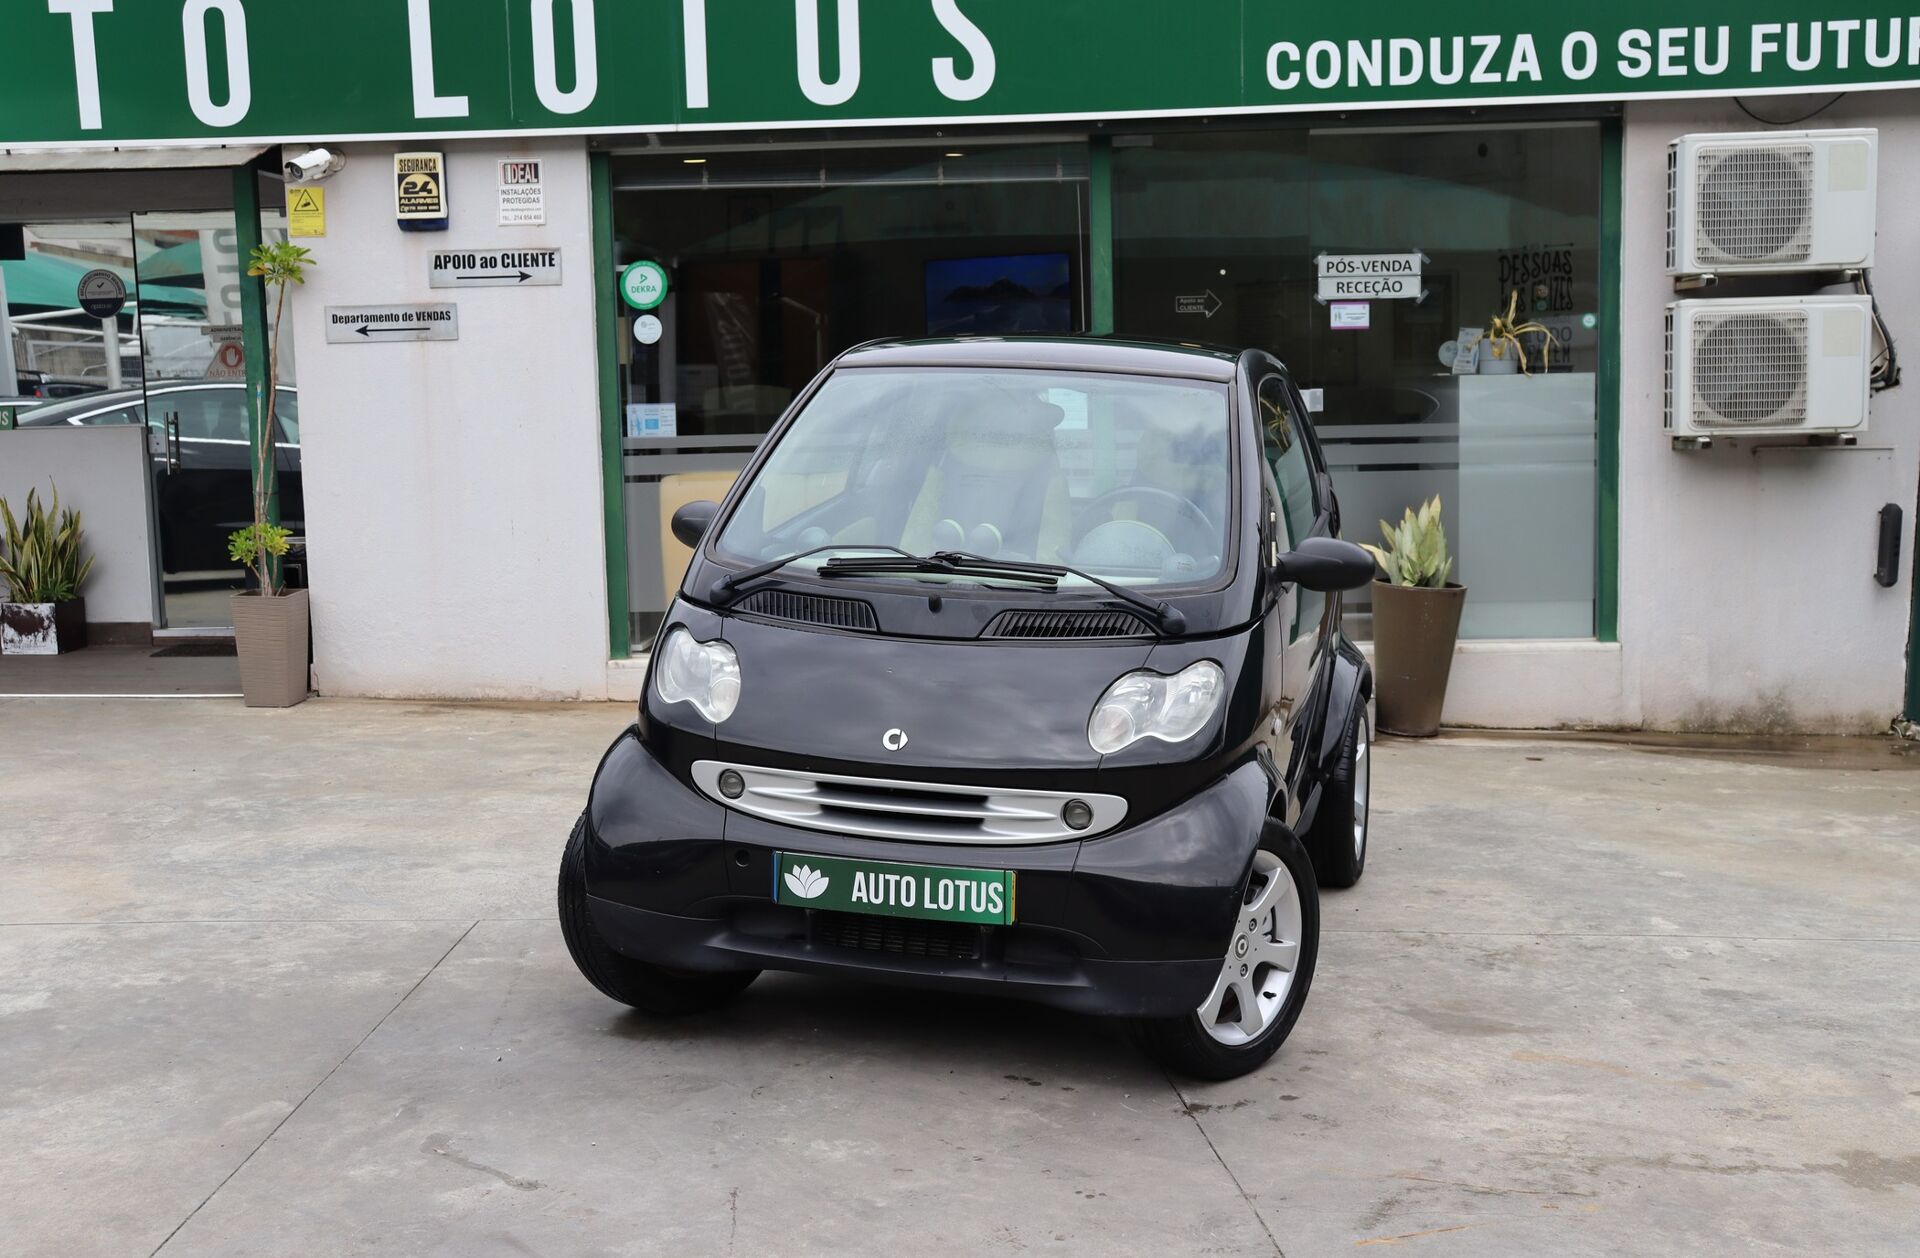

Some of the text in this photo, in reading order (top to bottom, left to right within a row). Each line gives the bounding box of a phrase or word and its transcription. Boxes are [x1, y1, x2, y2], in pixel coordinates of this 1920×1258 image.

[1266, 34, 1543, 90] CONDUZA
[1561, 31, 1598, 81] O
[1617, 26, 1730, 79] SEU
[403, 180, 433, 195] 24
[500, 187, 542, 197] INSTALAÇÕES
[400, 197, 439, 205] ALARMES
[502, 197, 540, 205] PROTEGIDAS
[433, 252, 556, 270] APOIO ao CLIENTE
[1326, 258, 1413, 273] PÓS-VENDA
[1499, 250, 1572, 294] PESSOAS
[631, 285, 657, 294] DEKRA
[1336, 277, 1403, 296] RECEÇÃO
[332, 310, 451, 324] Departamento de VENDAS
[209, 369, 226, 378] NÃO
[851, 871, 1004, 914] AUTO LOTUS
